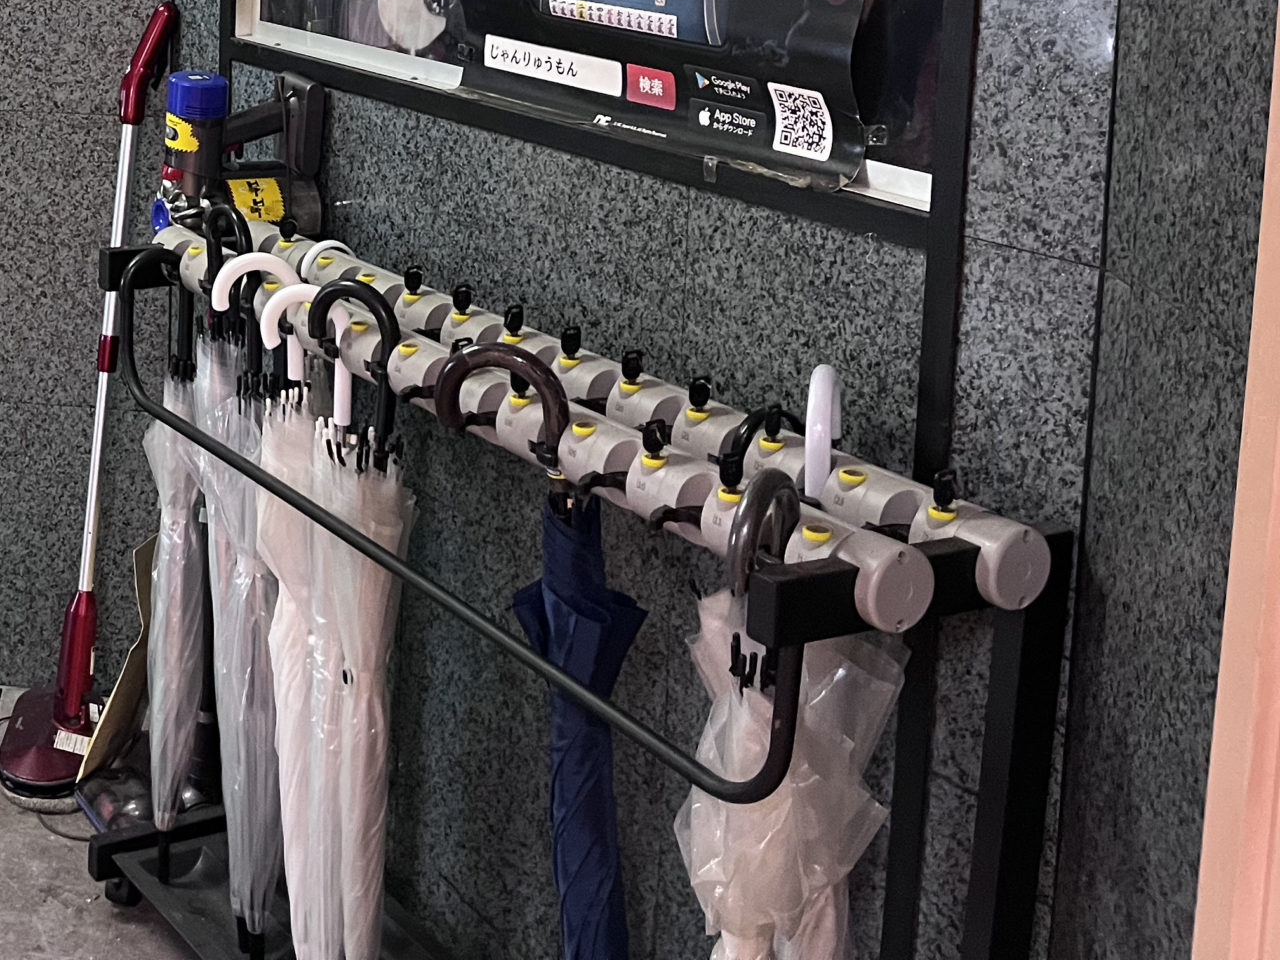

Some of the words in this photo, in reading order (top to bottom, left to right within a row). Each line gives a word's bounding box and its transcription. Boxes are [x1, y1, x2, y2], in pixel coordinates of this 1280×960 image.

[489, 45, 578, 78] じゃんりゅうもん
[638, 75, 664, 97] 検索
[713, 109, 731, 123] App
[732, 113, 757, 128] Store
